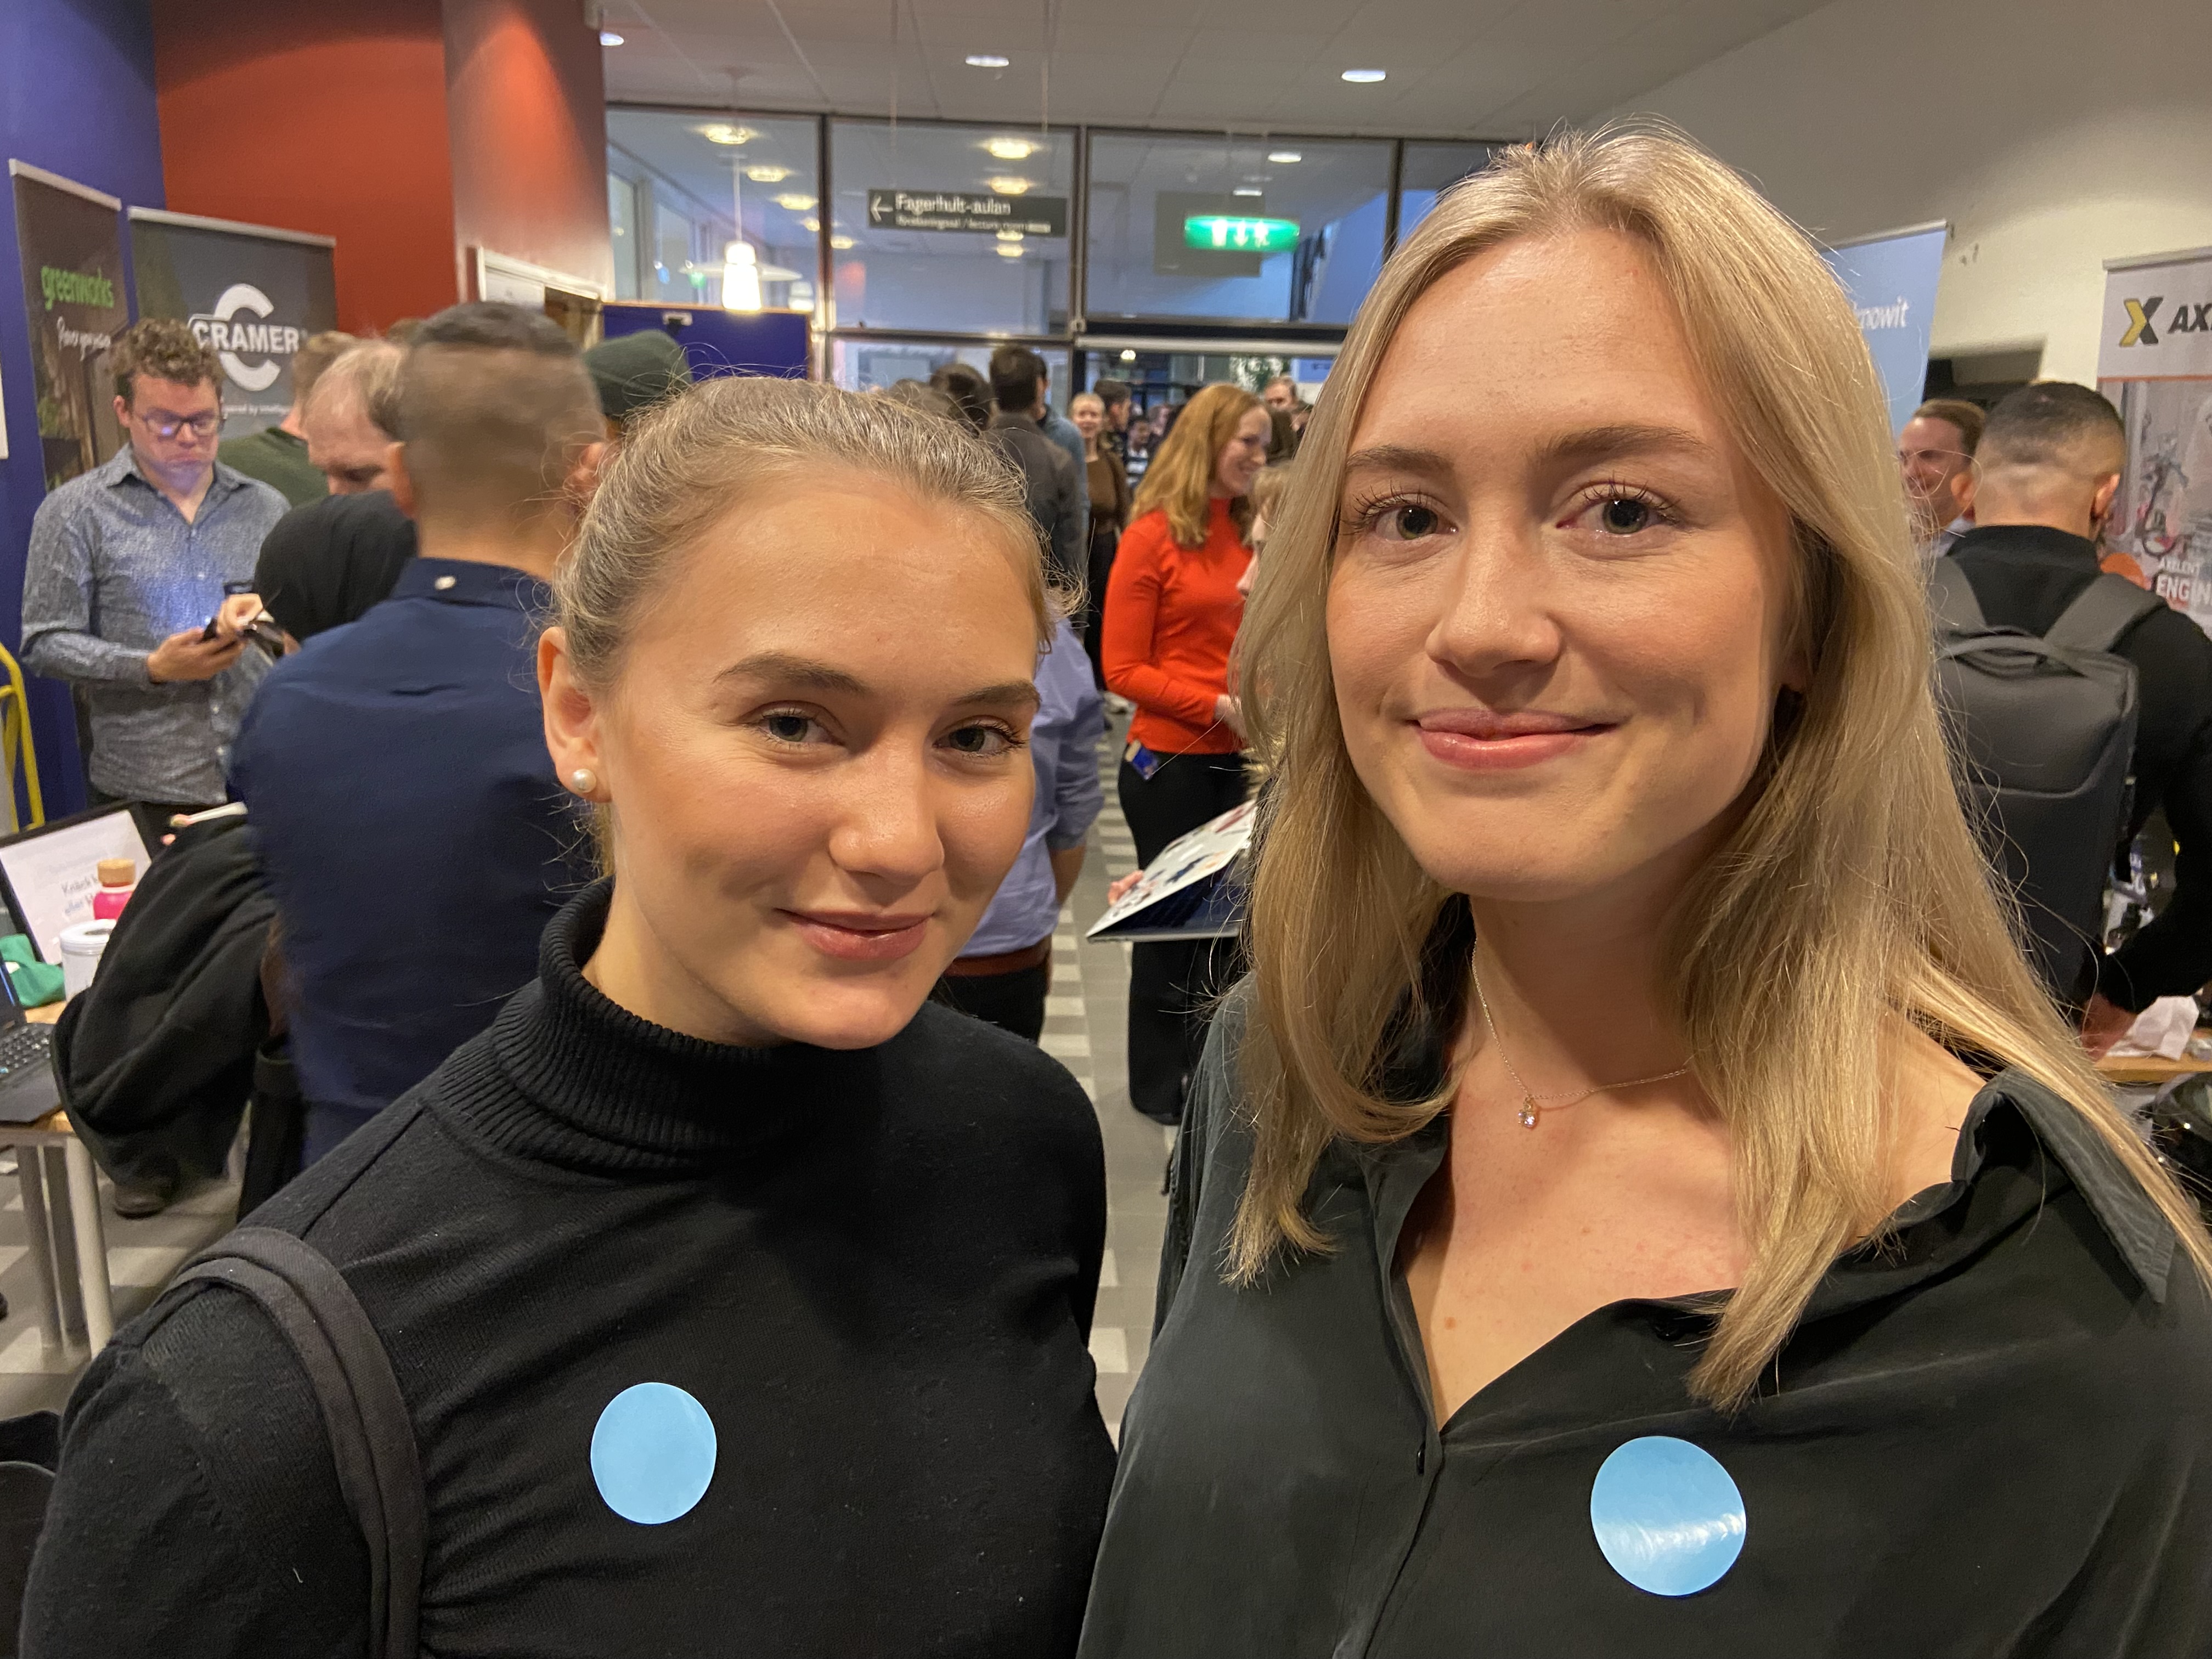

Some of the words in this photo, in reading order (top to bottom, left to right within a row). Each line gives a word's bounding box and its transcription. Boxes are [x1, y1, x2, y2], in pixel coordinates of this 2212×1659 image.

[1855, 295, 1909, 329] nowit
[2166, 302, 2212, 334] AX
[193, 320, 299, 354] CRAMER
